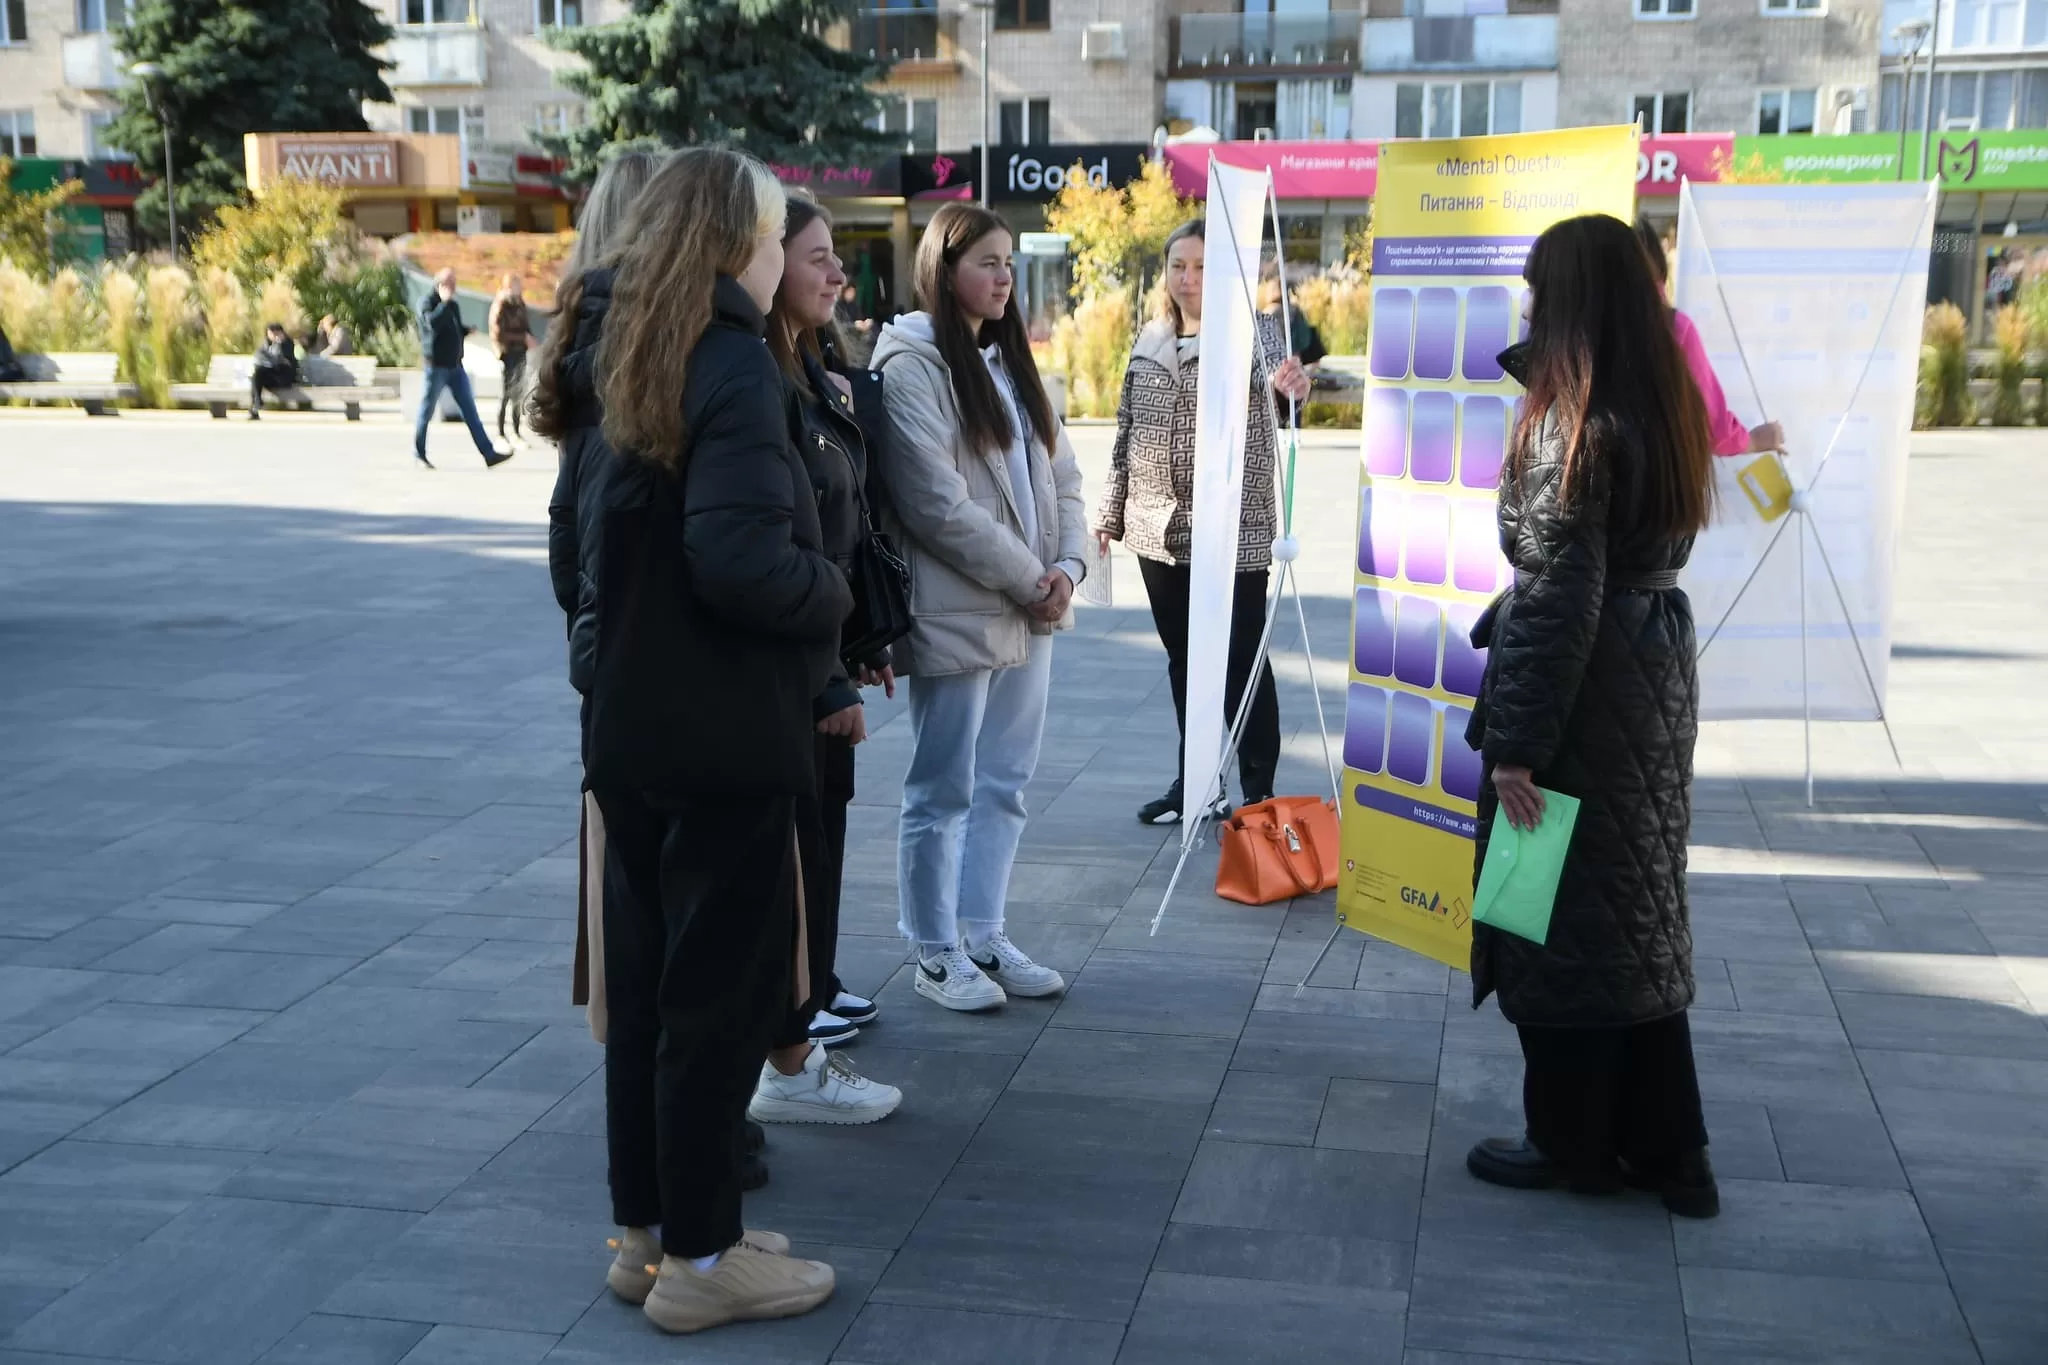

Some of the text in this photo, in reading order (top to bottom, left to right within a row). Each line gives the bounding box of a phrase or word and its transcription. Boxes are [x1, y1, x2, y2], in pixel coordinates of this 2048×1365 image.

[283, 153, 392, 181] AVANTI
[1436, 154, 1499, 177] «Mental
[1783, 153, 1896, 174] зоомаркет
[1420, 193, 1484, 213] Питання
[1502, 190, 1580, 212] Відповіді
[1400, 885, 1428, 910] GFA
